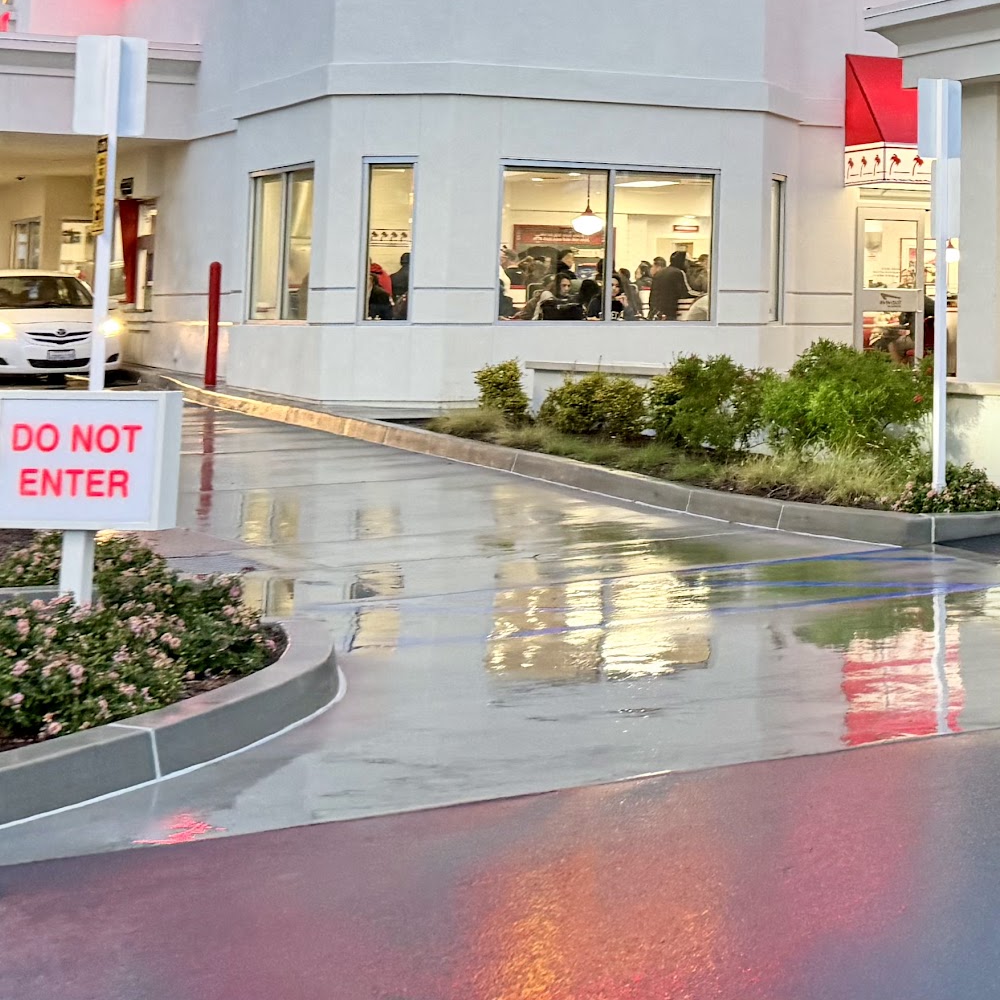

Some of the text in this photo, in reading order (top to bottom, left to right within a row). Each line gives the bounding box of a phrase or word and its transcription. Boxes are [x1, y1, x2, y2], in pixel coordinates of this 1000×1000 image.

[12, 423, 143, 453] DO NOT
[19, 468, 129, 498] ENTER
